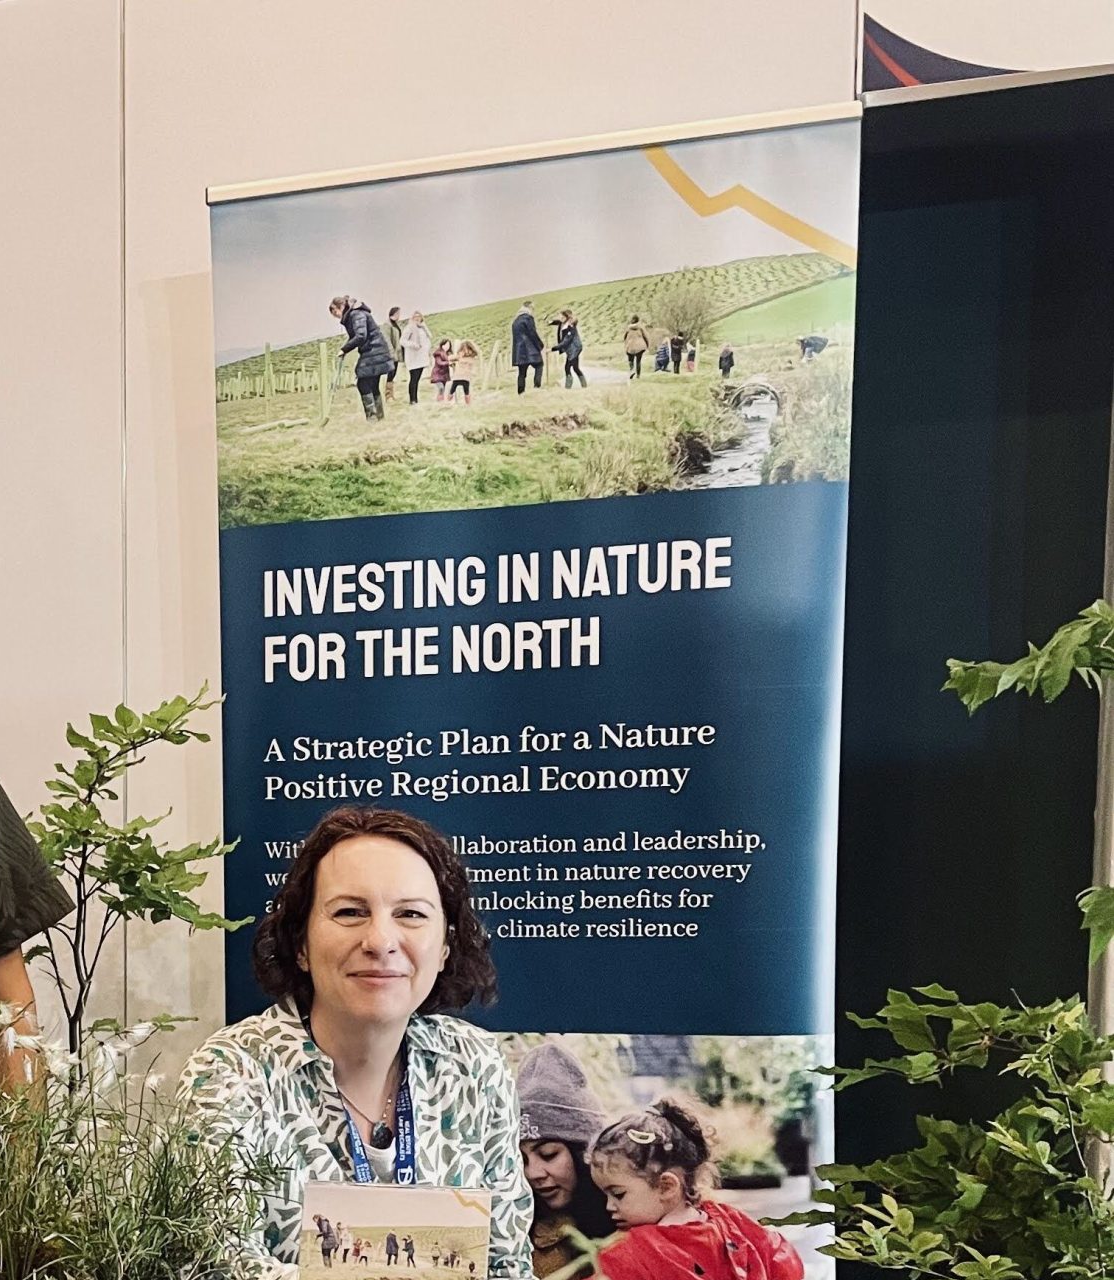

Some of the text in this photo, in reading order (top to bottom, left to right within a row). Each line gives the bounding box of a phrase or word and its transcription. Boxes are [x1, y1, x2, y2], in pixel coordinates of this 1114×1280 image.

[263, 536, 733, 618] INVESTING IN NATURE
[264, 616, 601, 683] FOR THE NORTH
[264, 722, 716, 764] A Strategic Plan for a Nature
[264, 766, 691, 801] Positive Regional Economy
[452, 834, 577, 854] llaboration
[582, 831, 627, 853] and
[632, 829, 767, 854] leadership,
[536, 863, 560, 881] in
[564, 864, 642, 881] nature
[646, 862, 752, 883] recovery
[579, 888, 673, 909] benefits
[677, 888, 714, 908] for
[496, 919, 580, 938] climate
[585, 917, 699, 938] resilience
